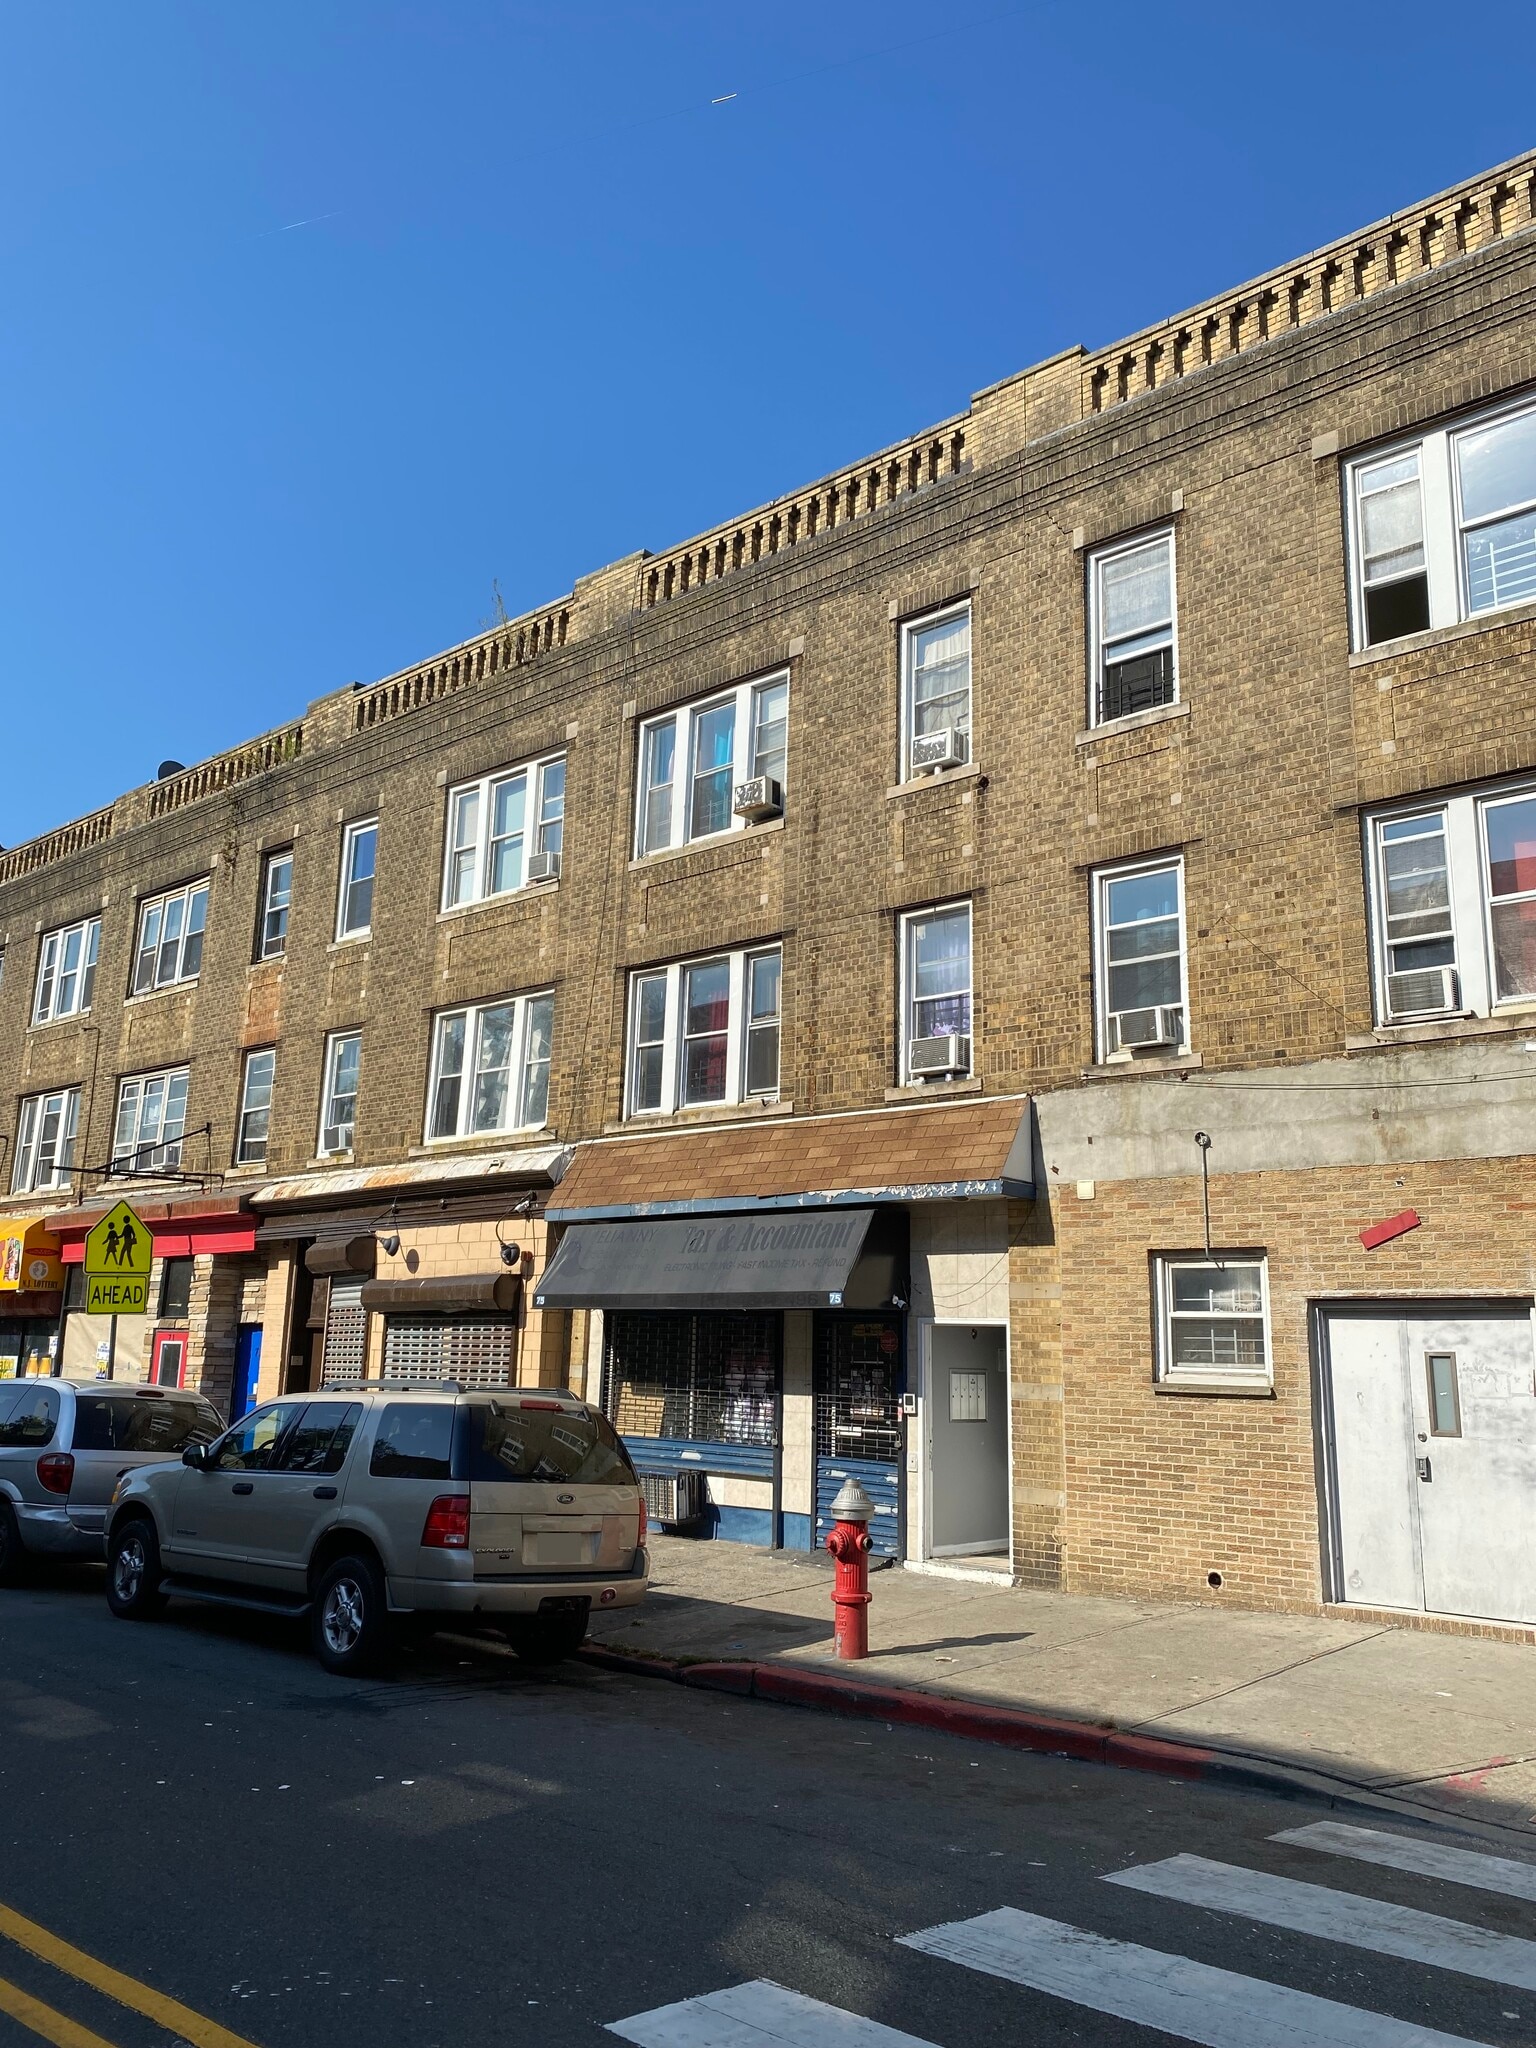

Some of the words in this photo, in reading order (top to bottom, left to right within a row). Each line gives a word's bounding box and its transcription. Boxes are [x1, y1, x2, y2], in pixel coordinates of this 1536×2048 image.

[679, 1226, 716, 1253] Tax
[736, 1218, 858, 1252] Accountant
[91, 1285, 143, 1304] AHEAD
[536, 1295, 545, 1305] 75
[829, 1292, 841, 1305] 75
